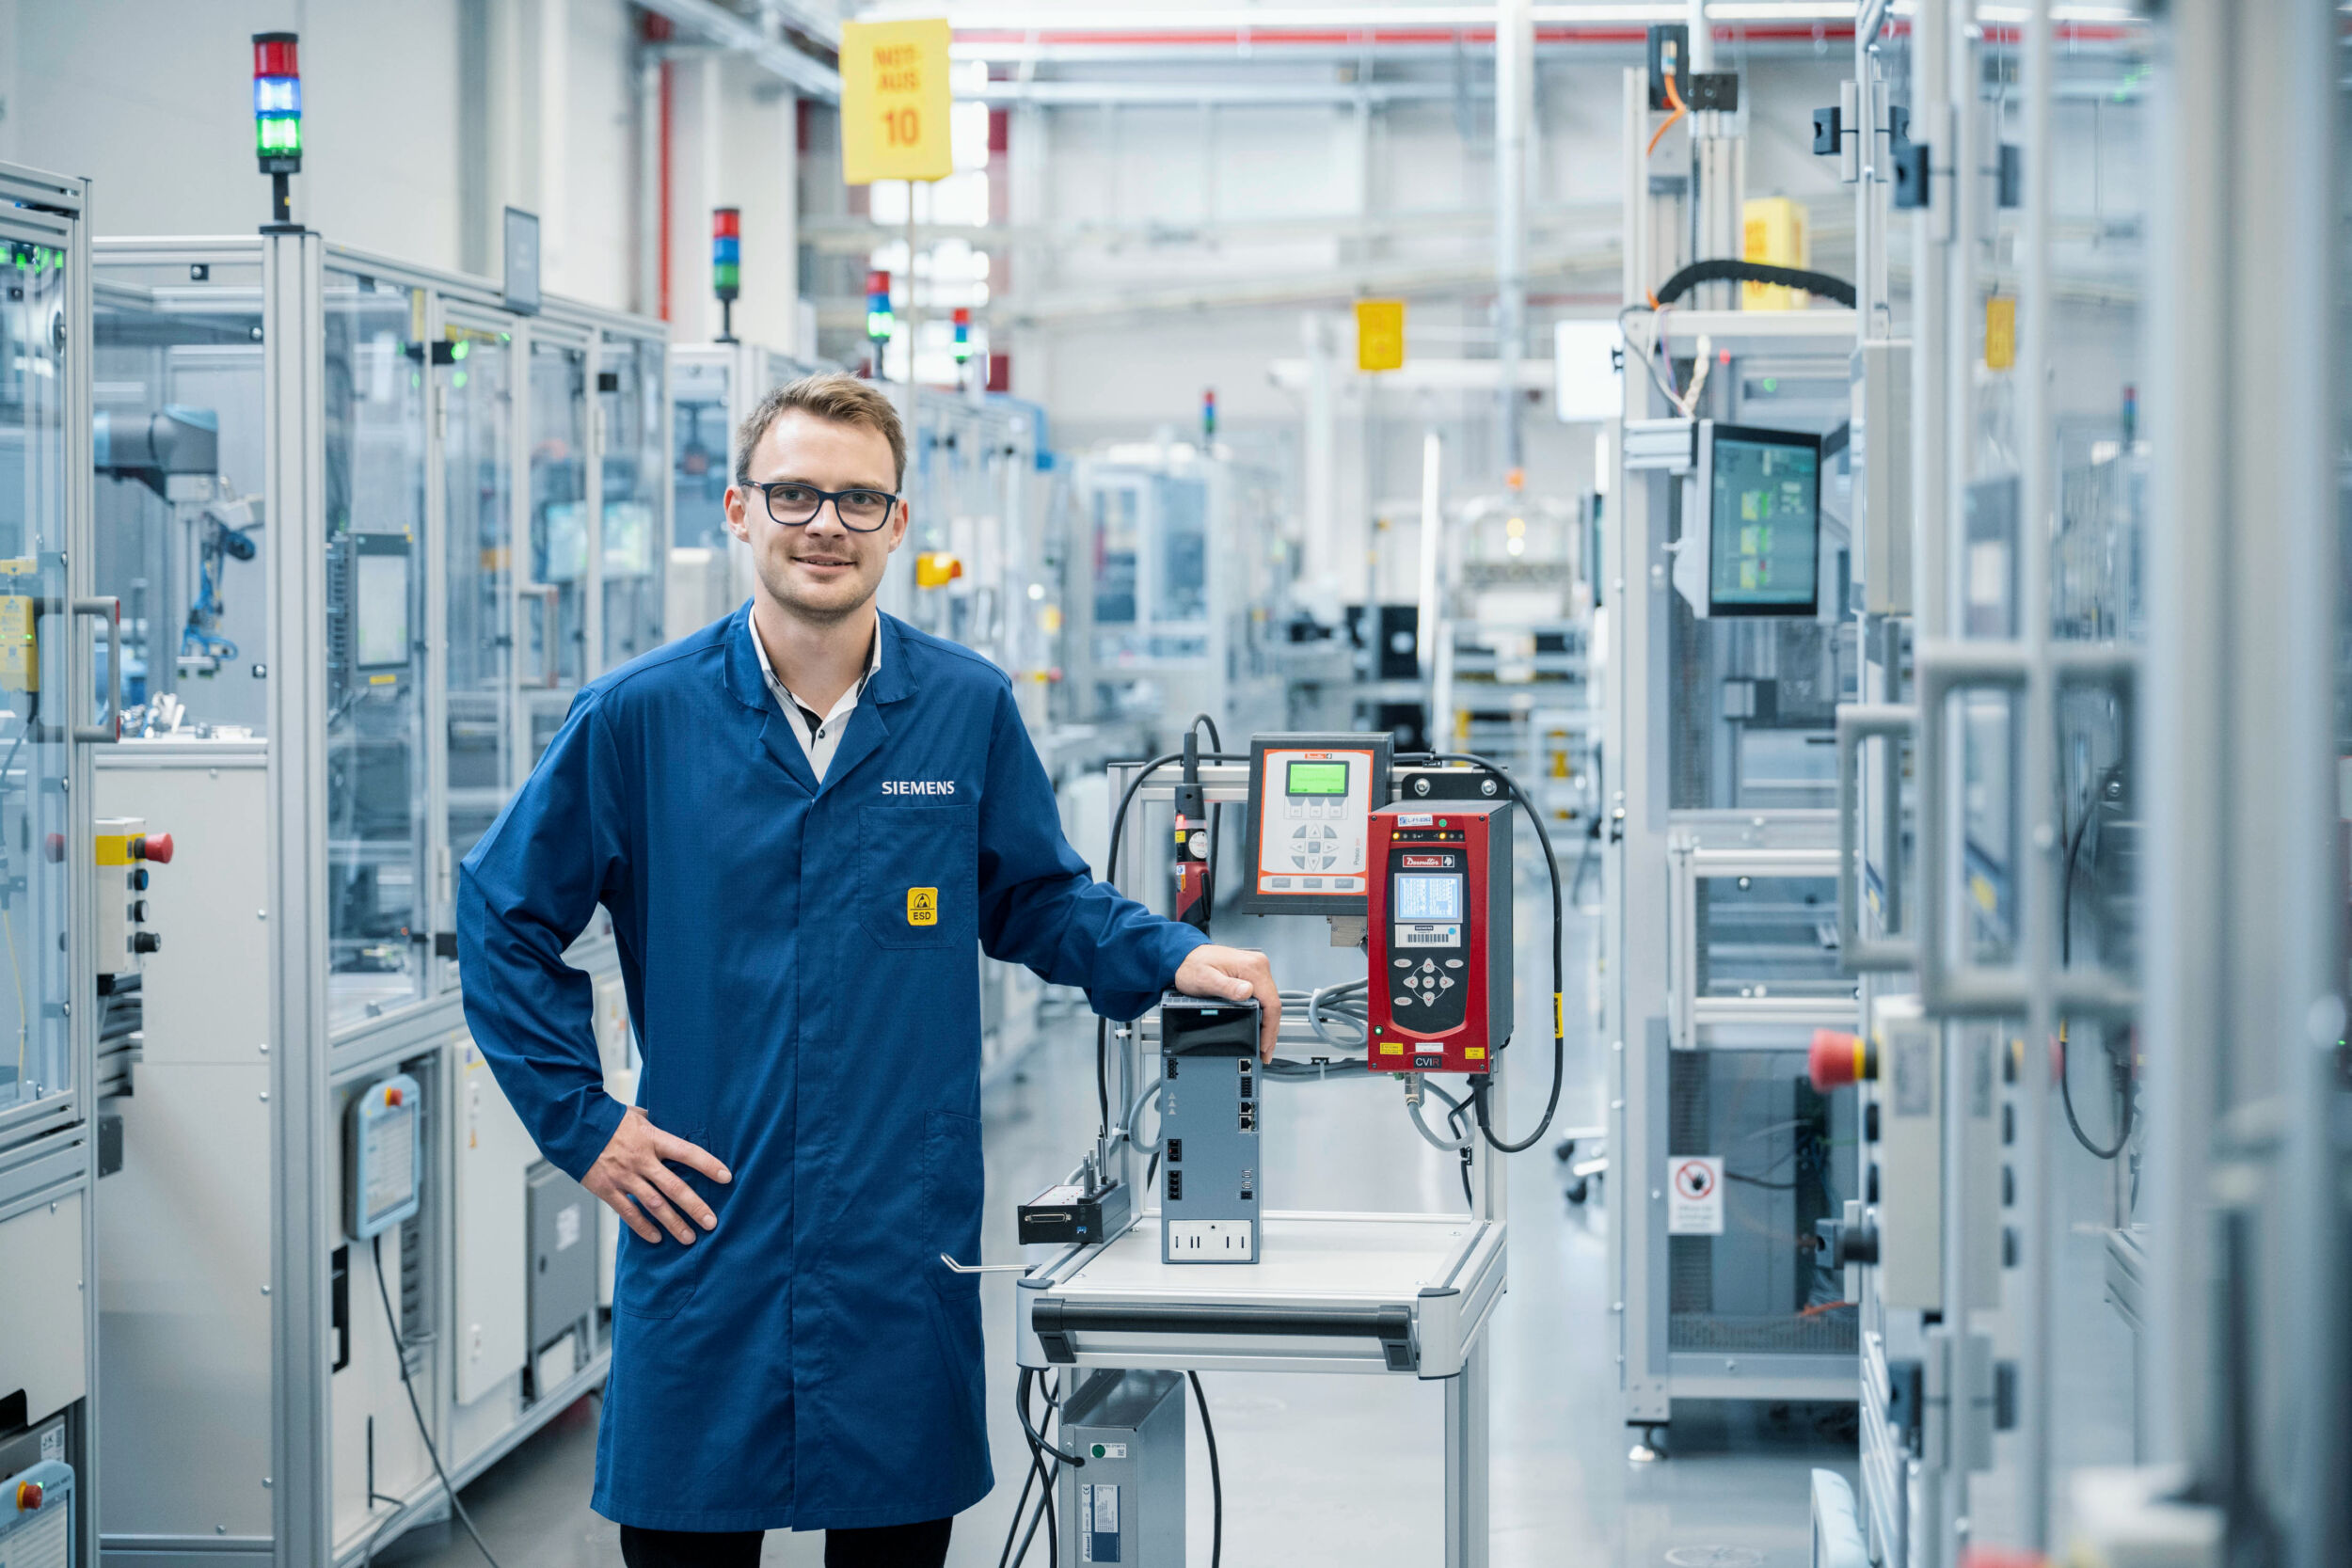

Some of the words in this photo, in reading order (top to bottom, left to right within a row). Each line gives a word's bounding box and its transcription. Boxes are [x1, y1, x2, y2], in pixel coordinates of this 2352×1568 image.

[882, 108, 919, 146] 10
[882, 781, 955, 796] SIEMENS
[913, 911, 931, 921] ESD
[1415, 1057, 1439, 1067] CVIR
